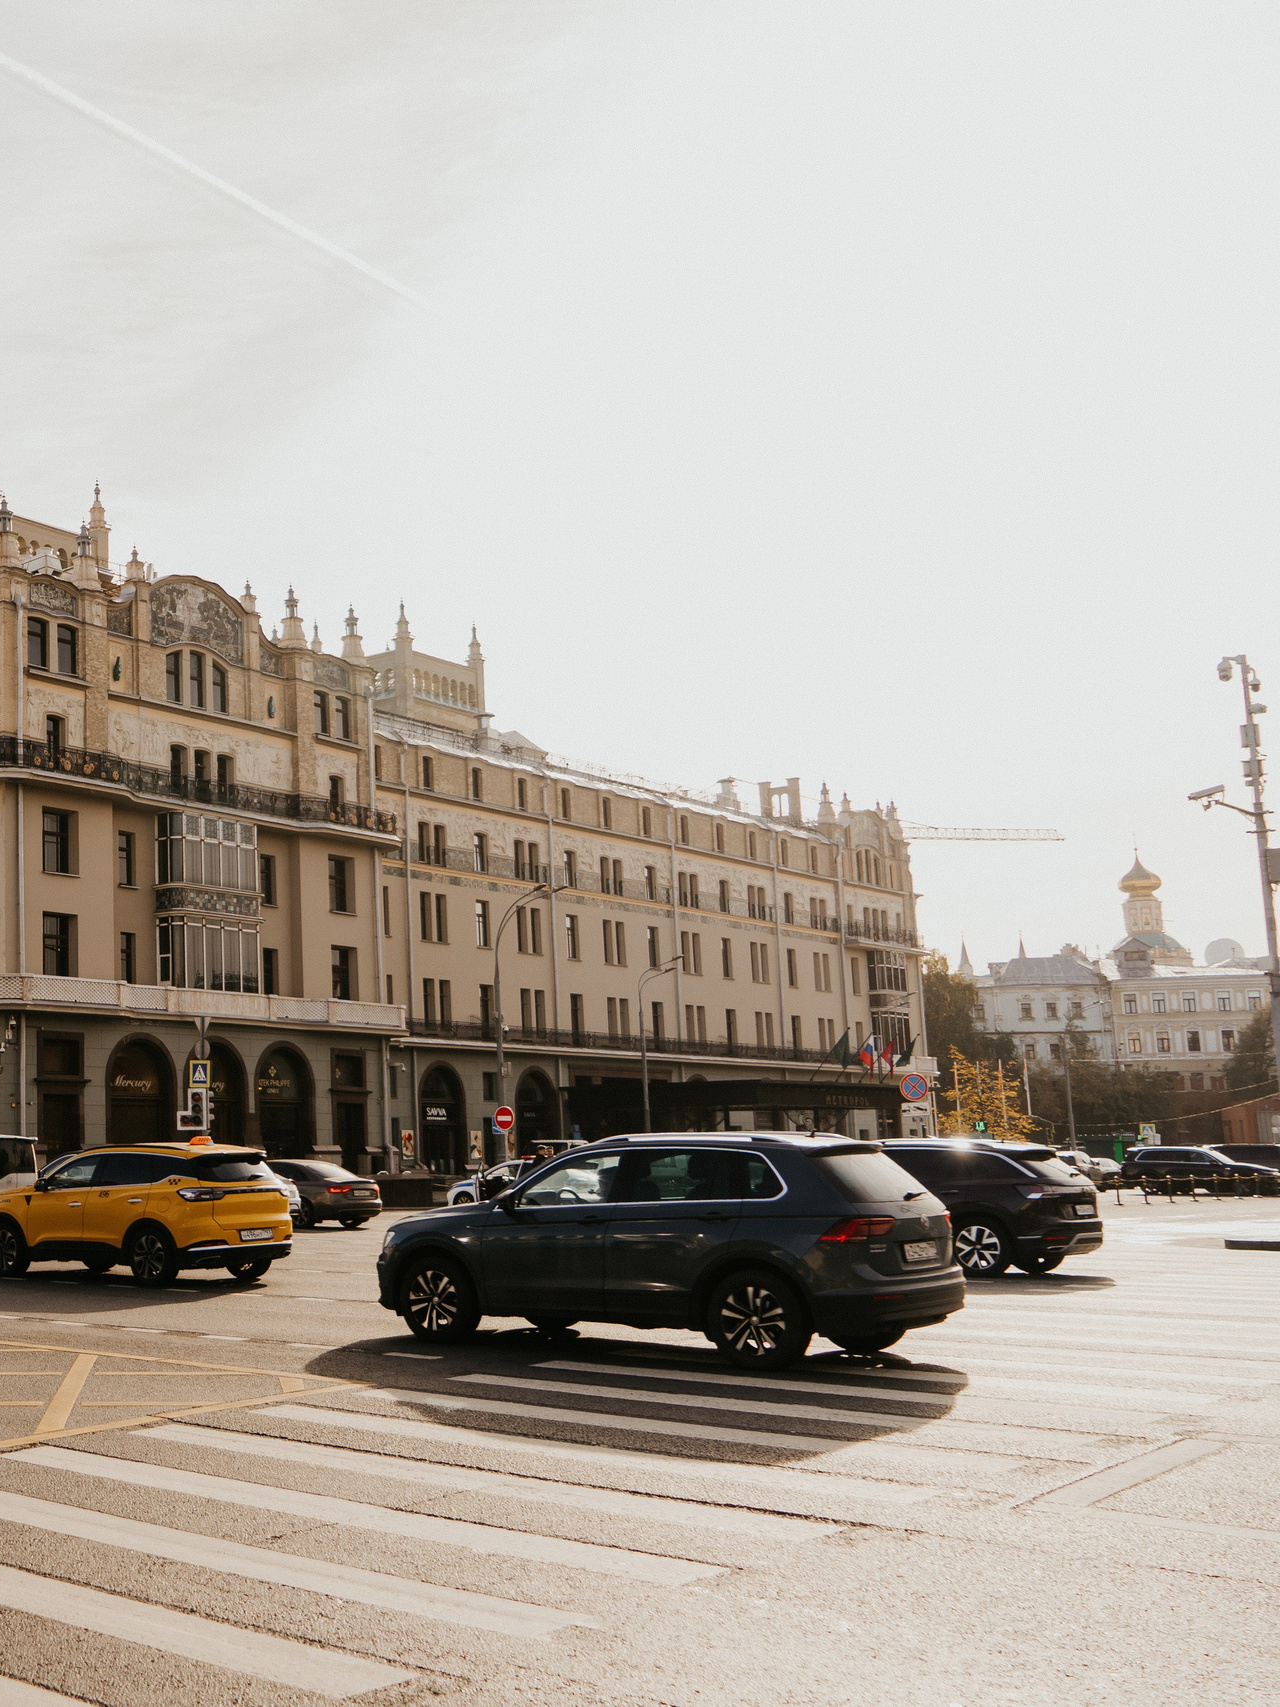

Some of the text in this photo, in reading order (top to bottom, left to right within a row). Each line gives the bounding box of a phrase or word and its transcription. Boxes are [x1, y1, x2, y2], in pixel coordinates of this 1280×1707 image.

[110, 1074, 152, 1091] Mercury
[825, 1095, 869, 1106] METROPOL
[426, 1107, 447, 1116] SAVVA
[98, 1190, 110, 1198] 496
